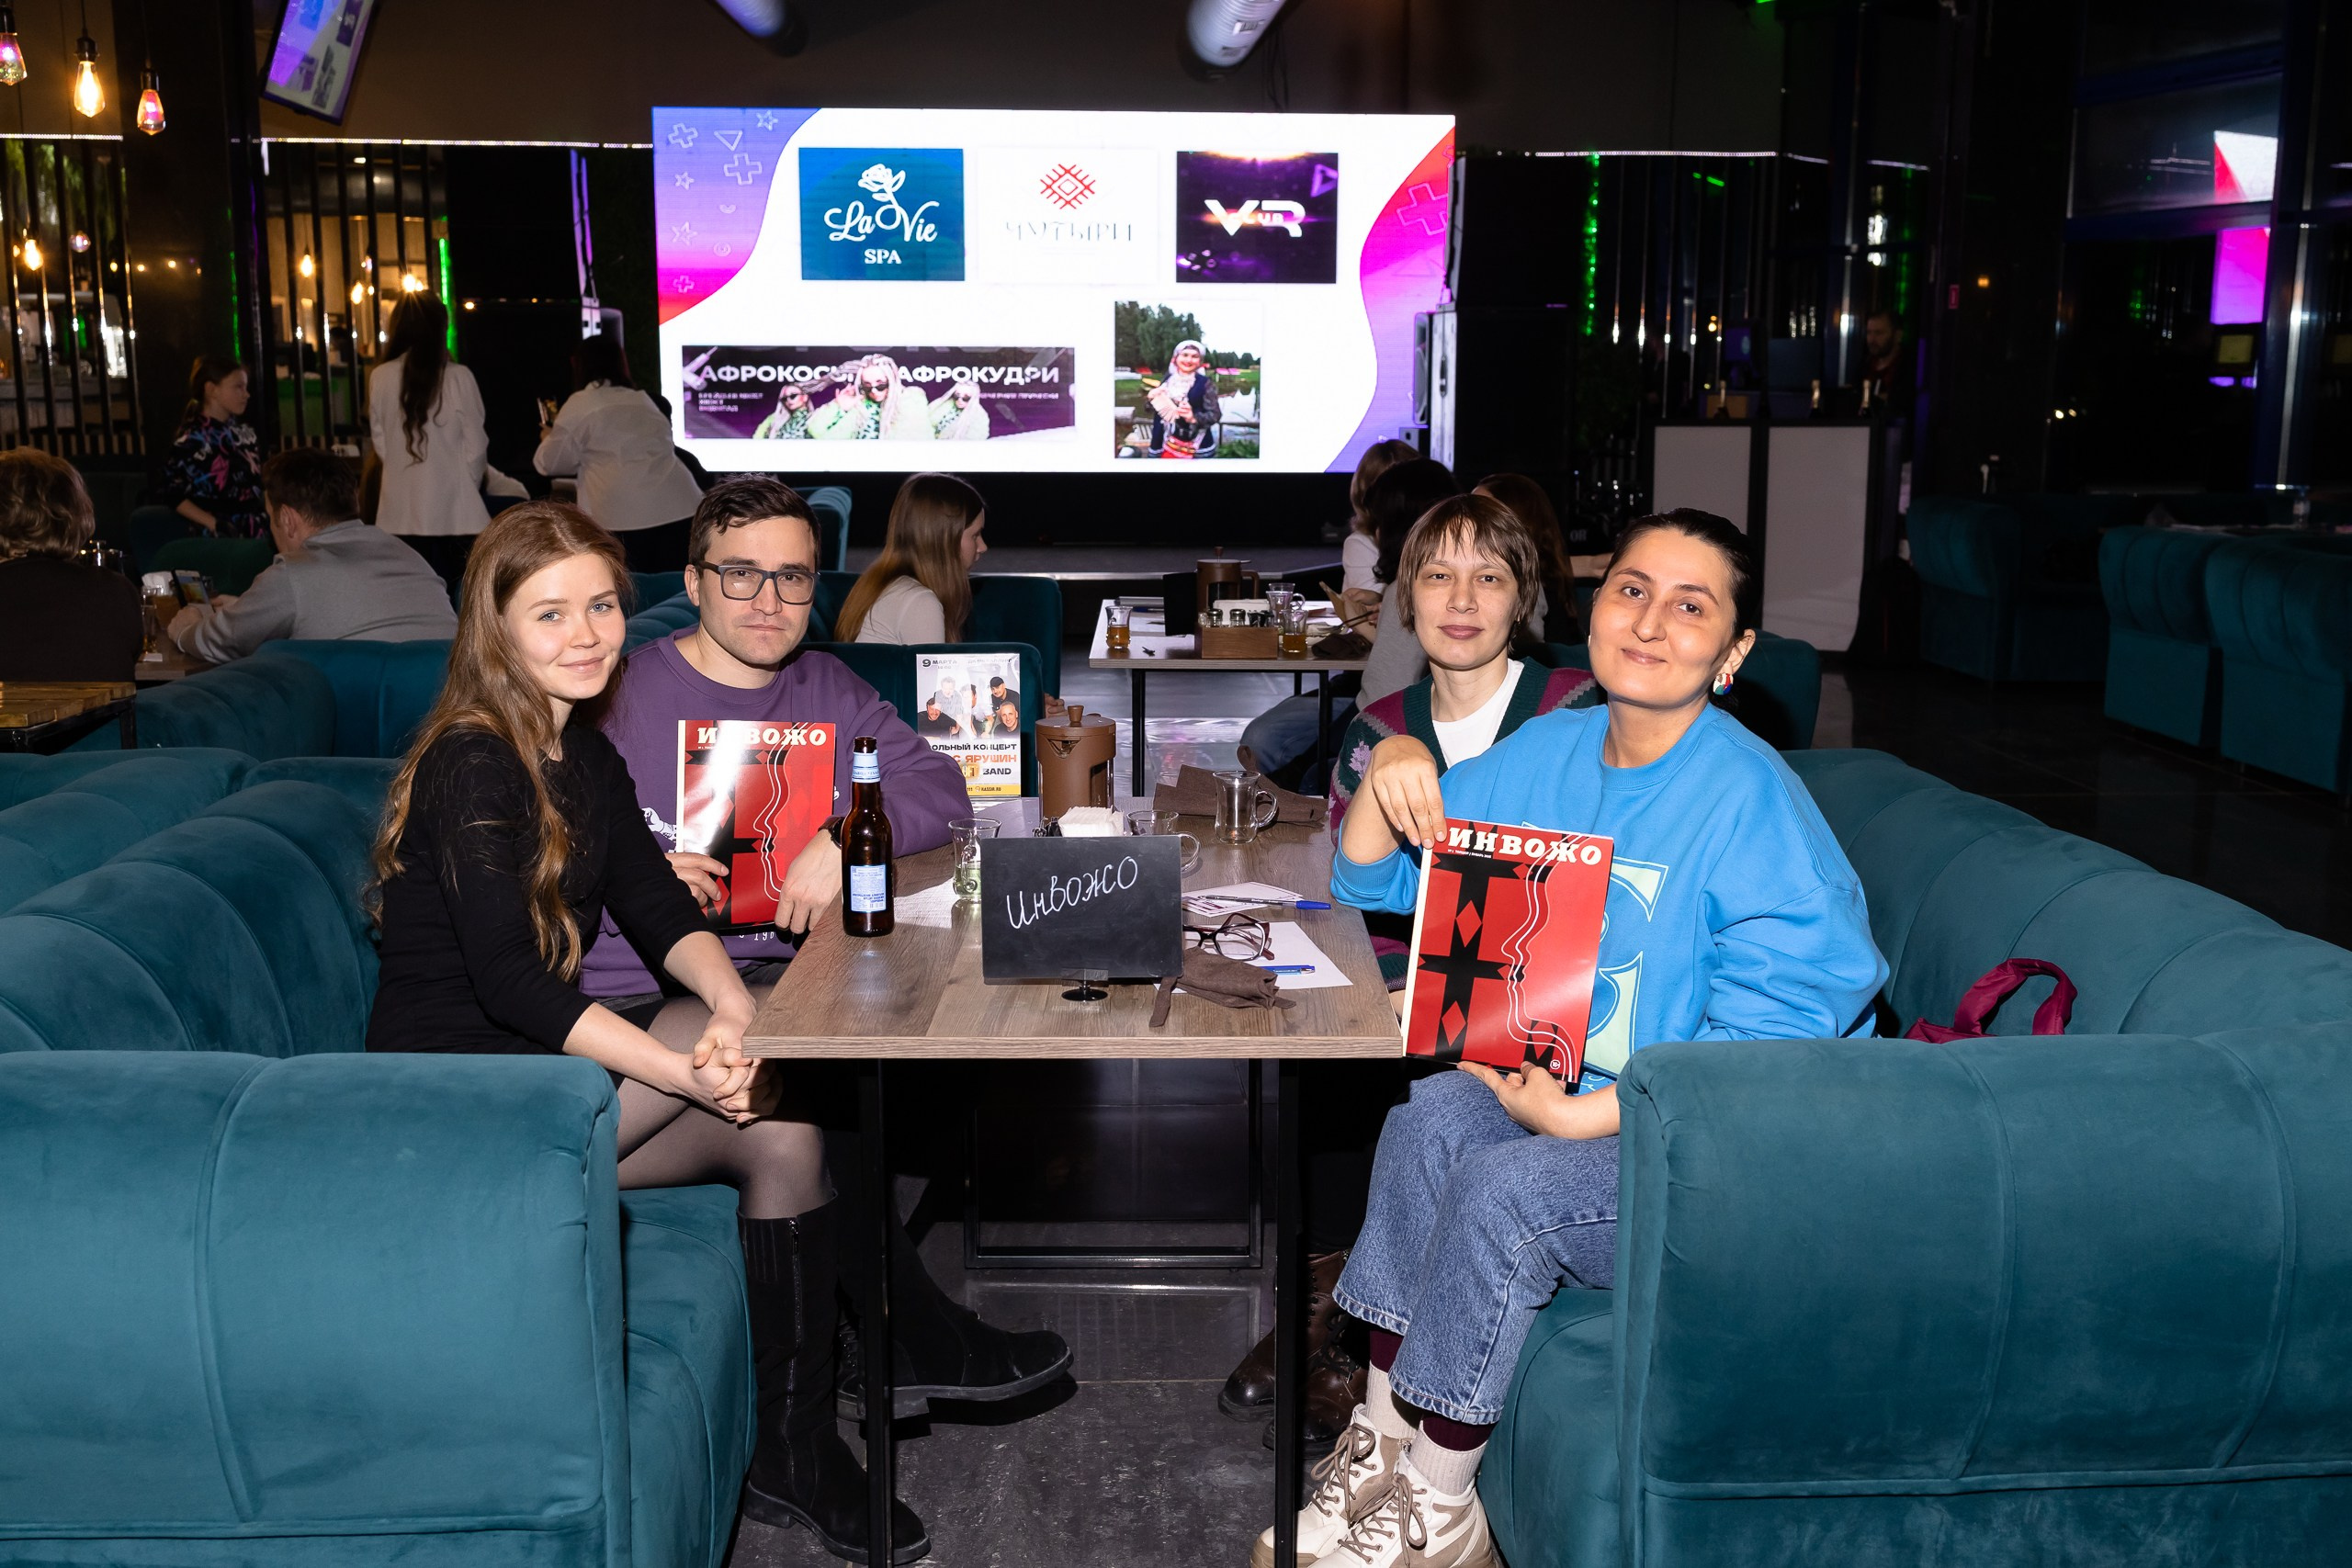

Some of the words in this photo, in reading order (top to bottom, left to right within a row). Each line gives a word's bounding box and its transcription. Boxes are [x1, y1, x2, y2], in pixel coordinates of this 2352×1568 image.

[824, 200, 875, 242] La
[899, 200, 940, 242] Vie
[864, 248, 902, 265] SPA
[898, 366, 1059, 386] АФРОКУДРИ
[922, 659, 932, 668] 9
[696, 727, 828, 746] ИВОЖО
[931, 742, 971, 751] ОЛЬНЫЙ
[965, 754, 1017, 763] ЯРУШИН
[1447, 827, 1602, 865] ИНВОЖО
